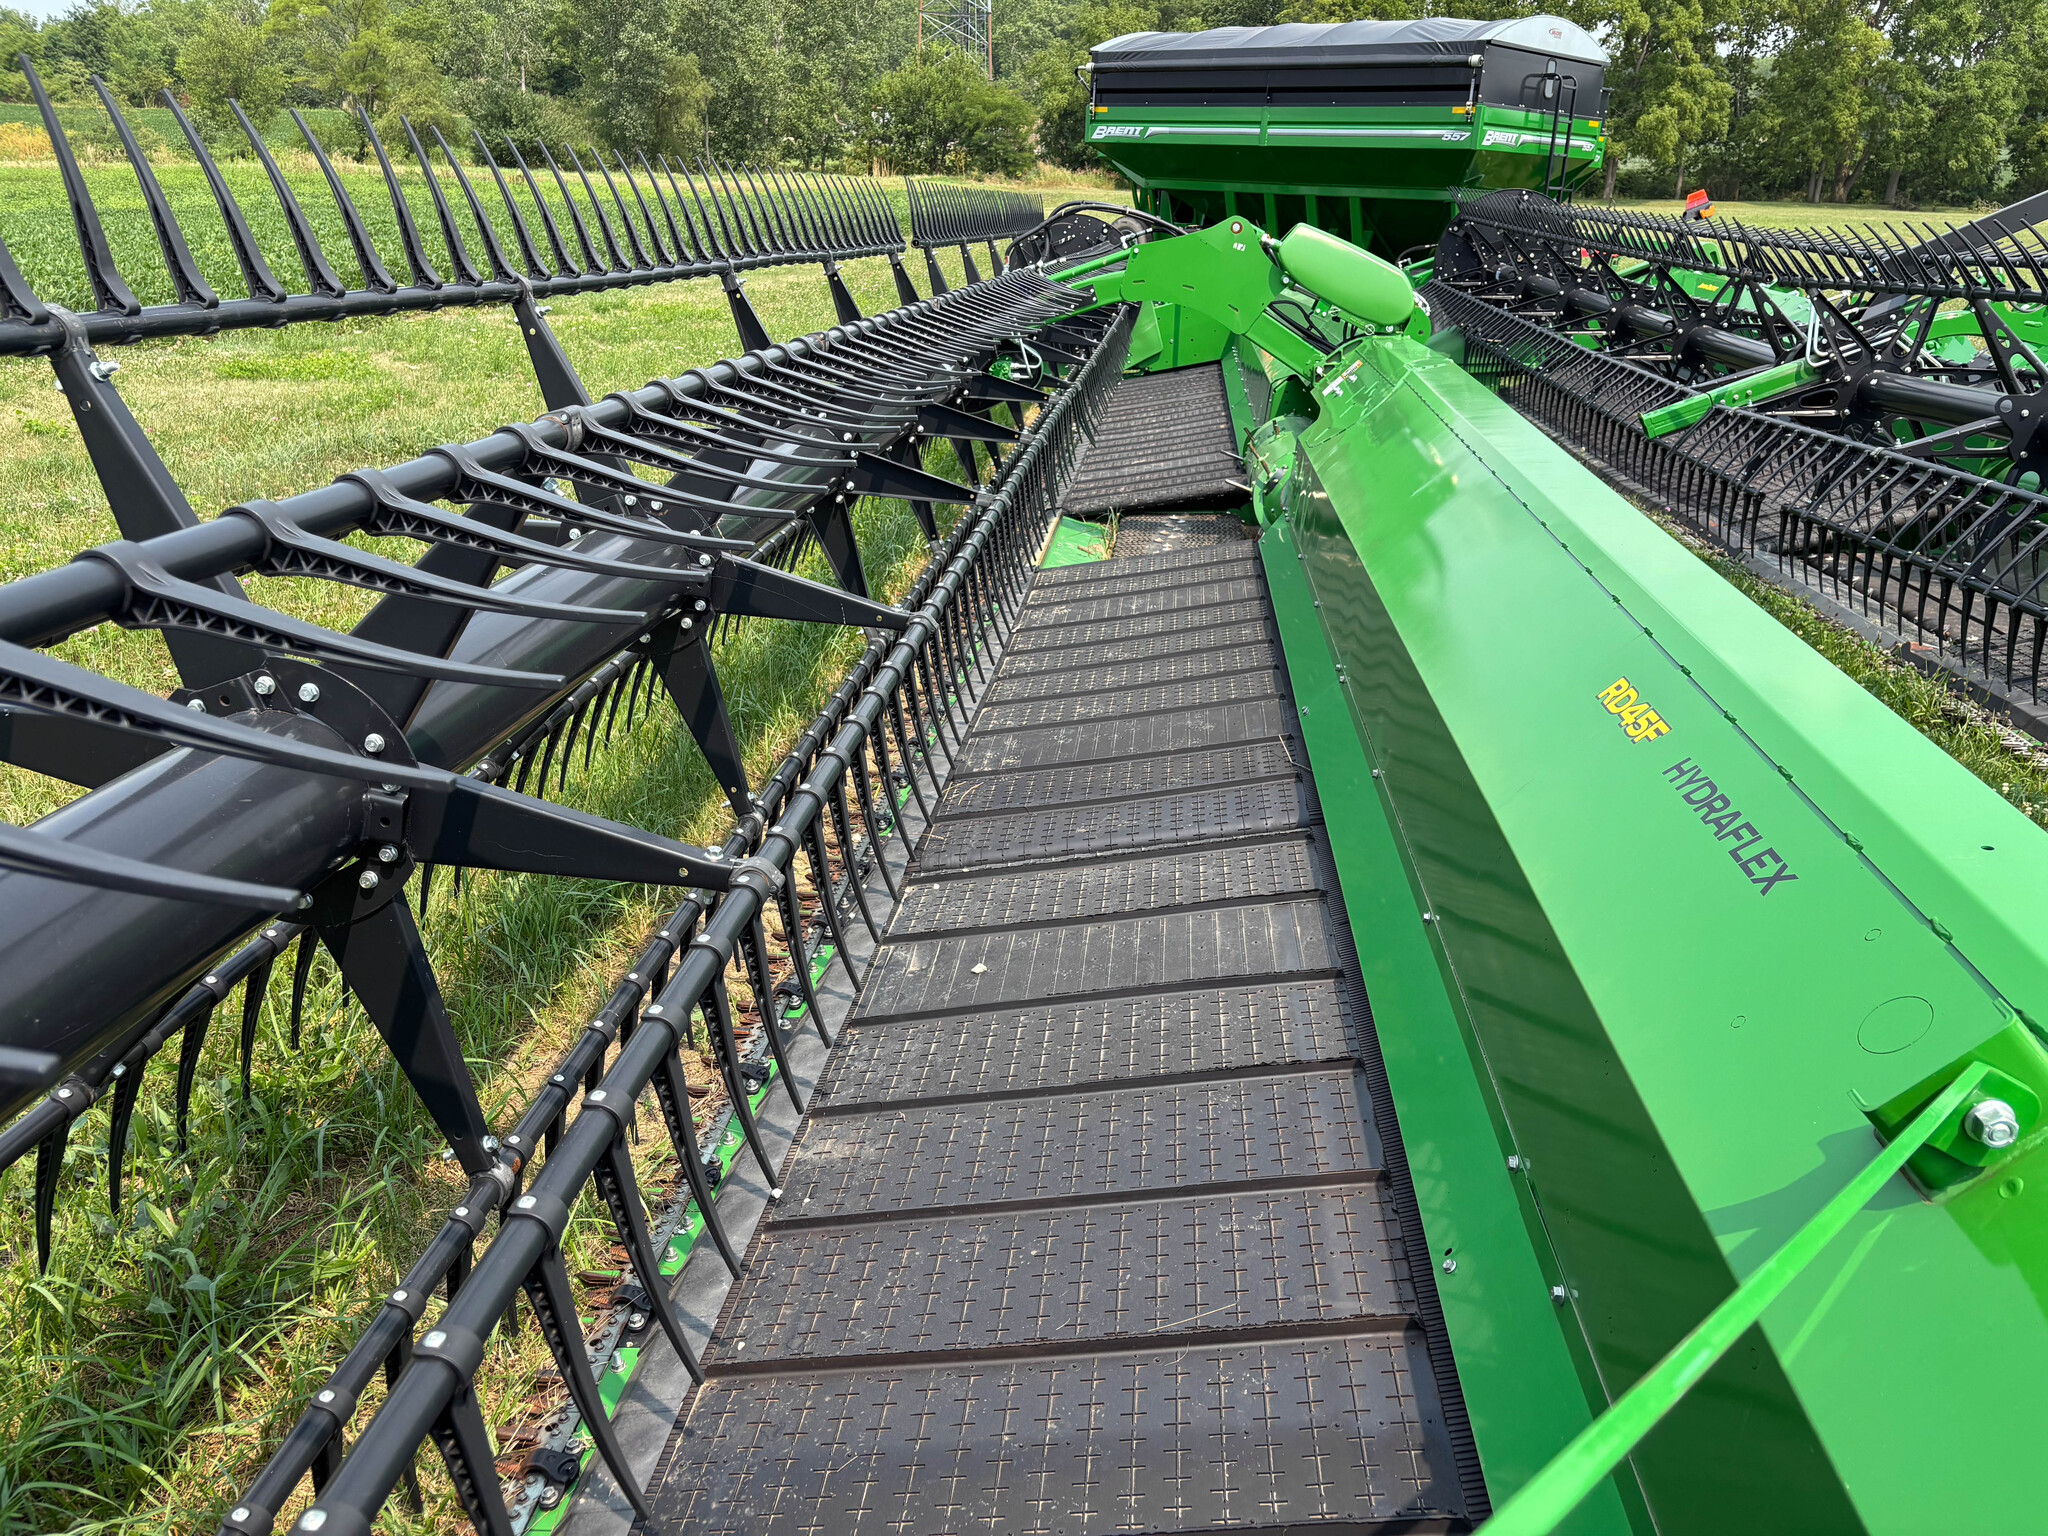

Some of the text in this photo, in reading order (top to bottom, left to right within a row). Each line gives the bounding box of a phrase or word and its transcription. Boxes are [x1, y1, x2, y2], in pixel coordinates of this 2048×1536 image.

[1091, 125, 1144, 140] BRENT
[1441, 130, 1471, 141] 557
[1481, 130, 1519, 147] BRENT
[1595, 675, 1672, 744] RD45F
[1661, 756, 1800, 897] HYDRAFLEX
